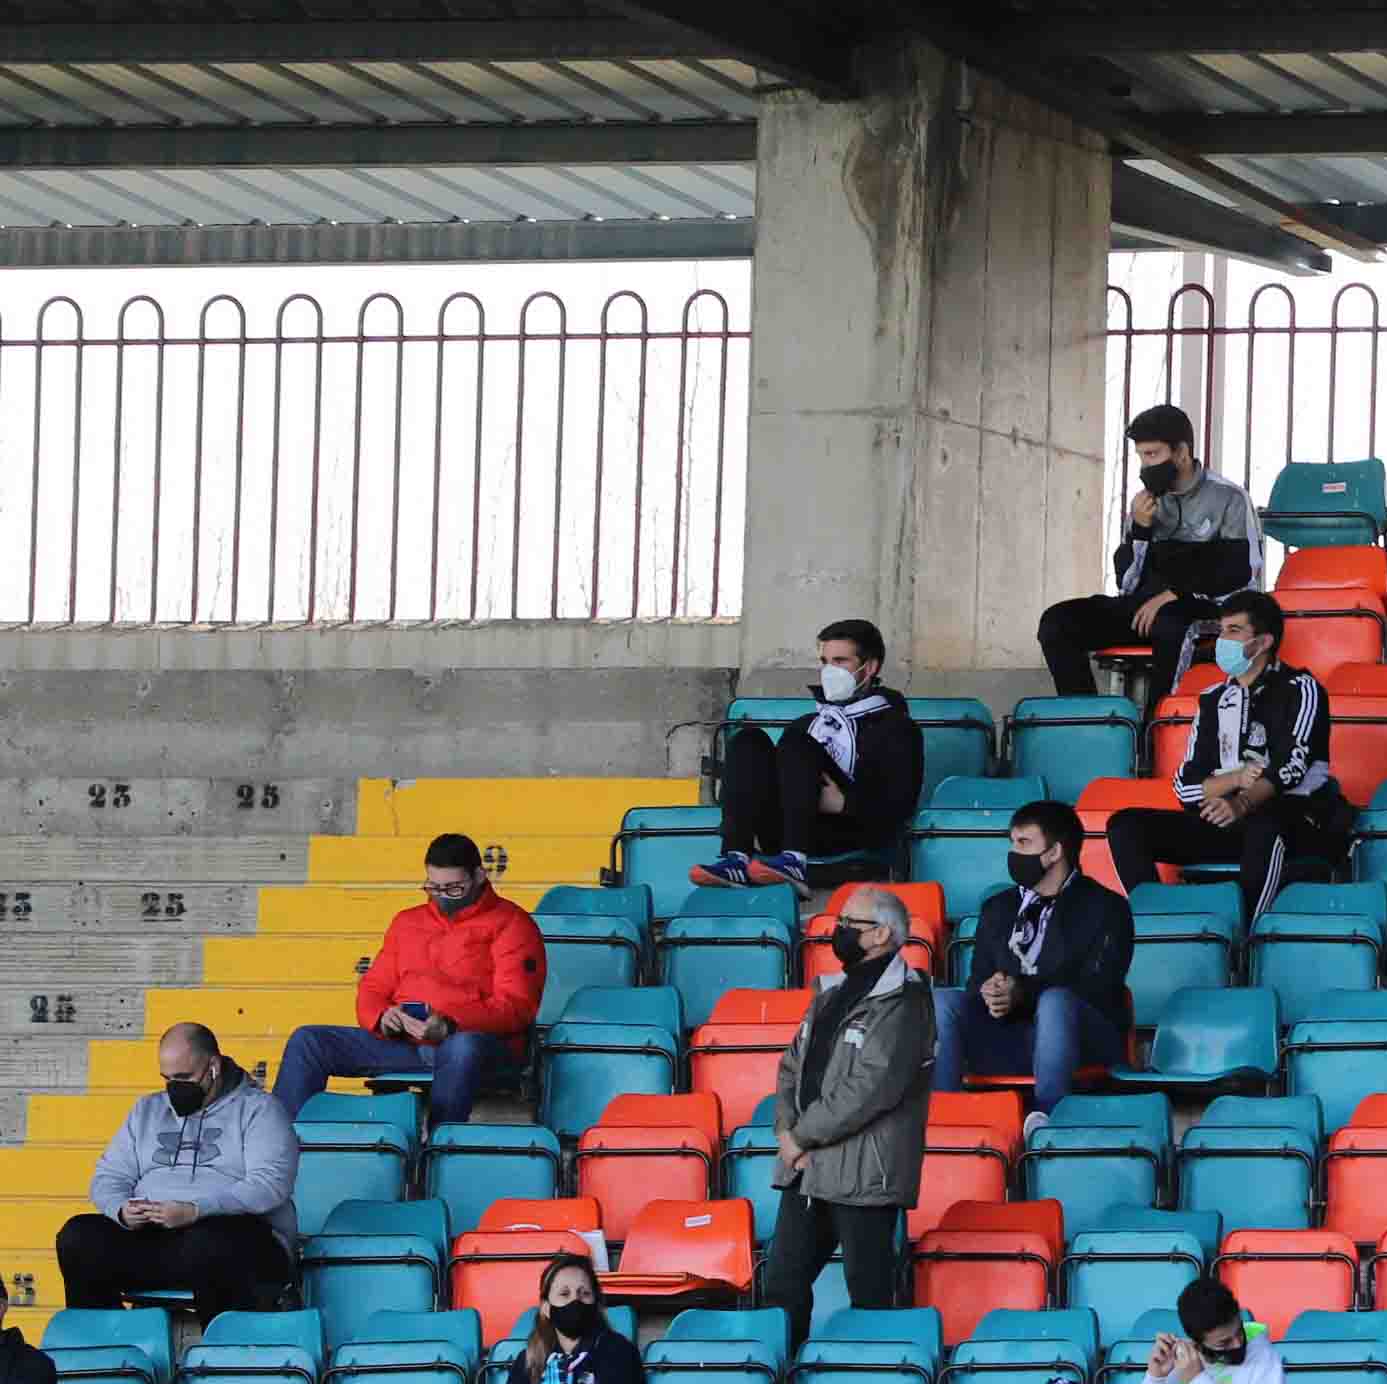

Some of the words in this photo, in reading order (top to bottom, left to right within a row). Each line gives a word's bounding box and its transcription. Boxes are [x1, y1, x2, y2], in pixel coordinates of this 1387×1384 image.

[236, 784, 280, 809] 25
[0, 892, 32, 921] 5
[140, 893, 187, 922] 25
